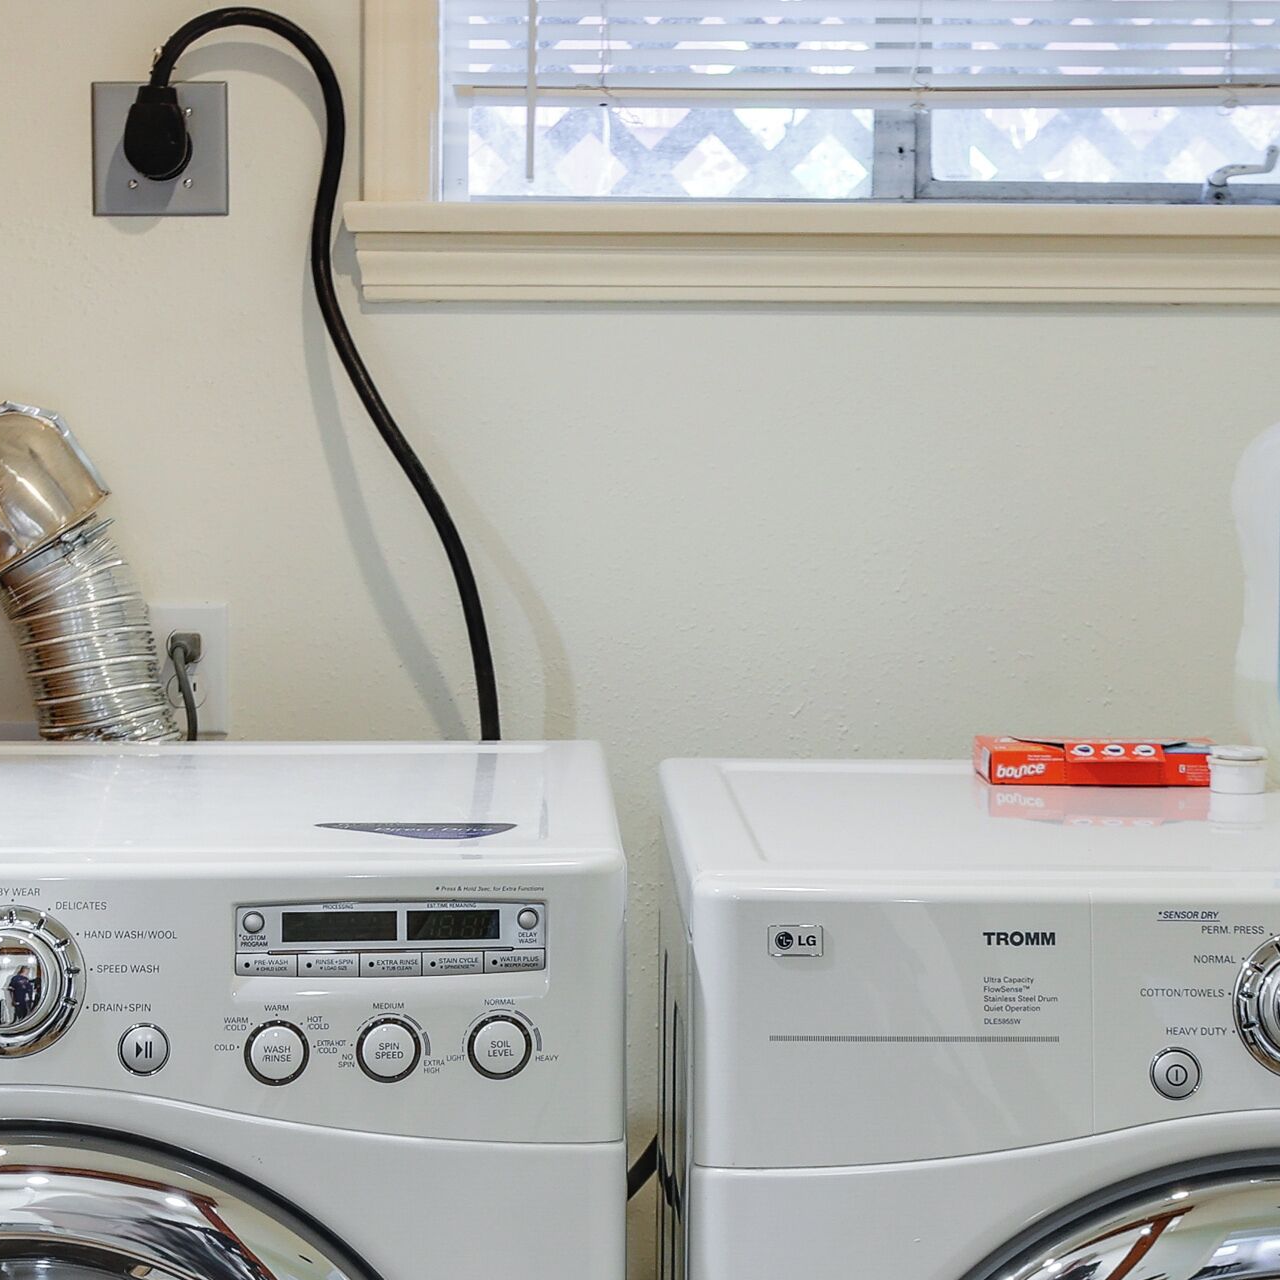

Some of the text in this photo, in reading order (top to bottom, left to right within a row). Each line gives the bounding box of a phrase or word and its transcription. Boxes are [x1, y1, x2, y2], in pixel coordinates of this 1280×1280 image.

[996, 763, 1046, 778] bounce
[12, 888, 40, 896] WEAR
[55, 902, 107, 911] DELICATES
[1200, 911, 1219, 920] DRY
[84, 930, 177, 939] HAND WASH/WOOL
[1201, 925, 1264, 935] PERM. PRESS
[798, 935, 816, 946] LG
[983, 931, 1056, 946] TROMM
[1193, 955, 1236, 964] NORMAL
[96, 965, 160, 974] SPEED WASH
[1003, 976, 1034, 984] Capacity
[1140, 988, 1225, 998] COTTON/TOWELS
[372, 1002, 405, 1010] MEDIUM
[484, 998, 516, 1006] NORMAL
[92, 1003, 152, 1012] DRAIN+SPIN
[1005, 1005, 1040, 1013] Operation
[1166, 1027, 1227, 1036] HEAVY DUTY
[378, 1042, 400, 1050] SPIN
[375, 1051, 404, 1059] SPEED
[487, 1049, 514, 1057] LEVEL
[261, 1054, 292, 1062] /RINSE
